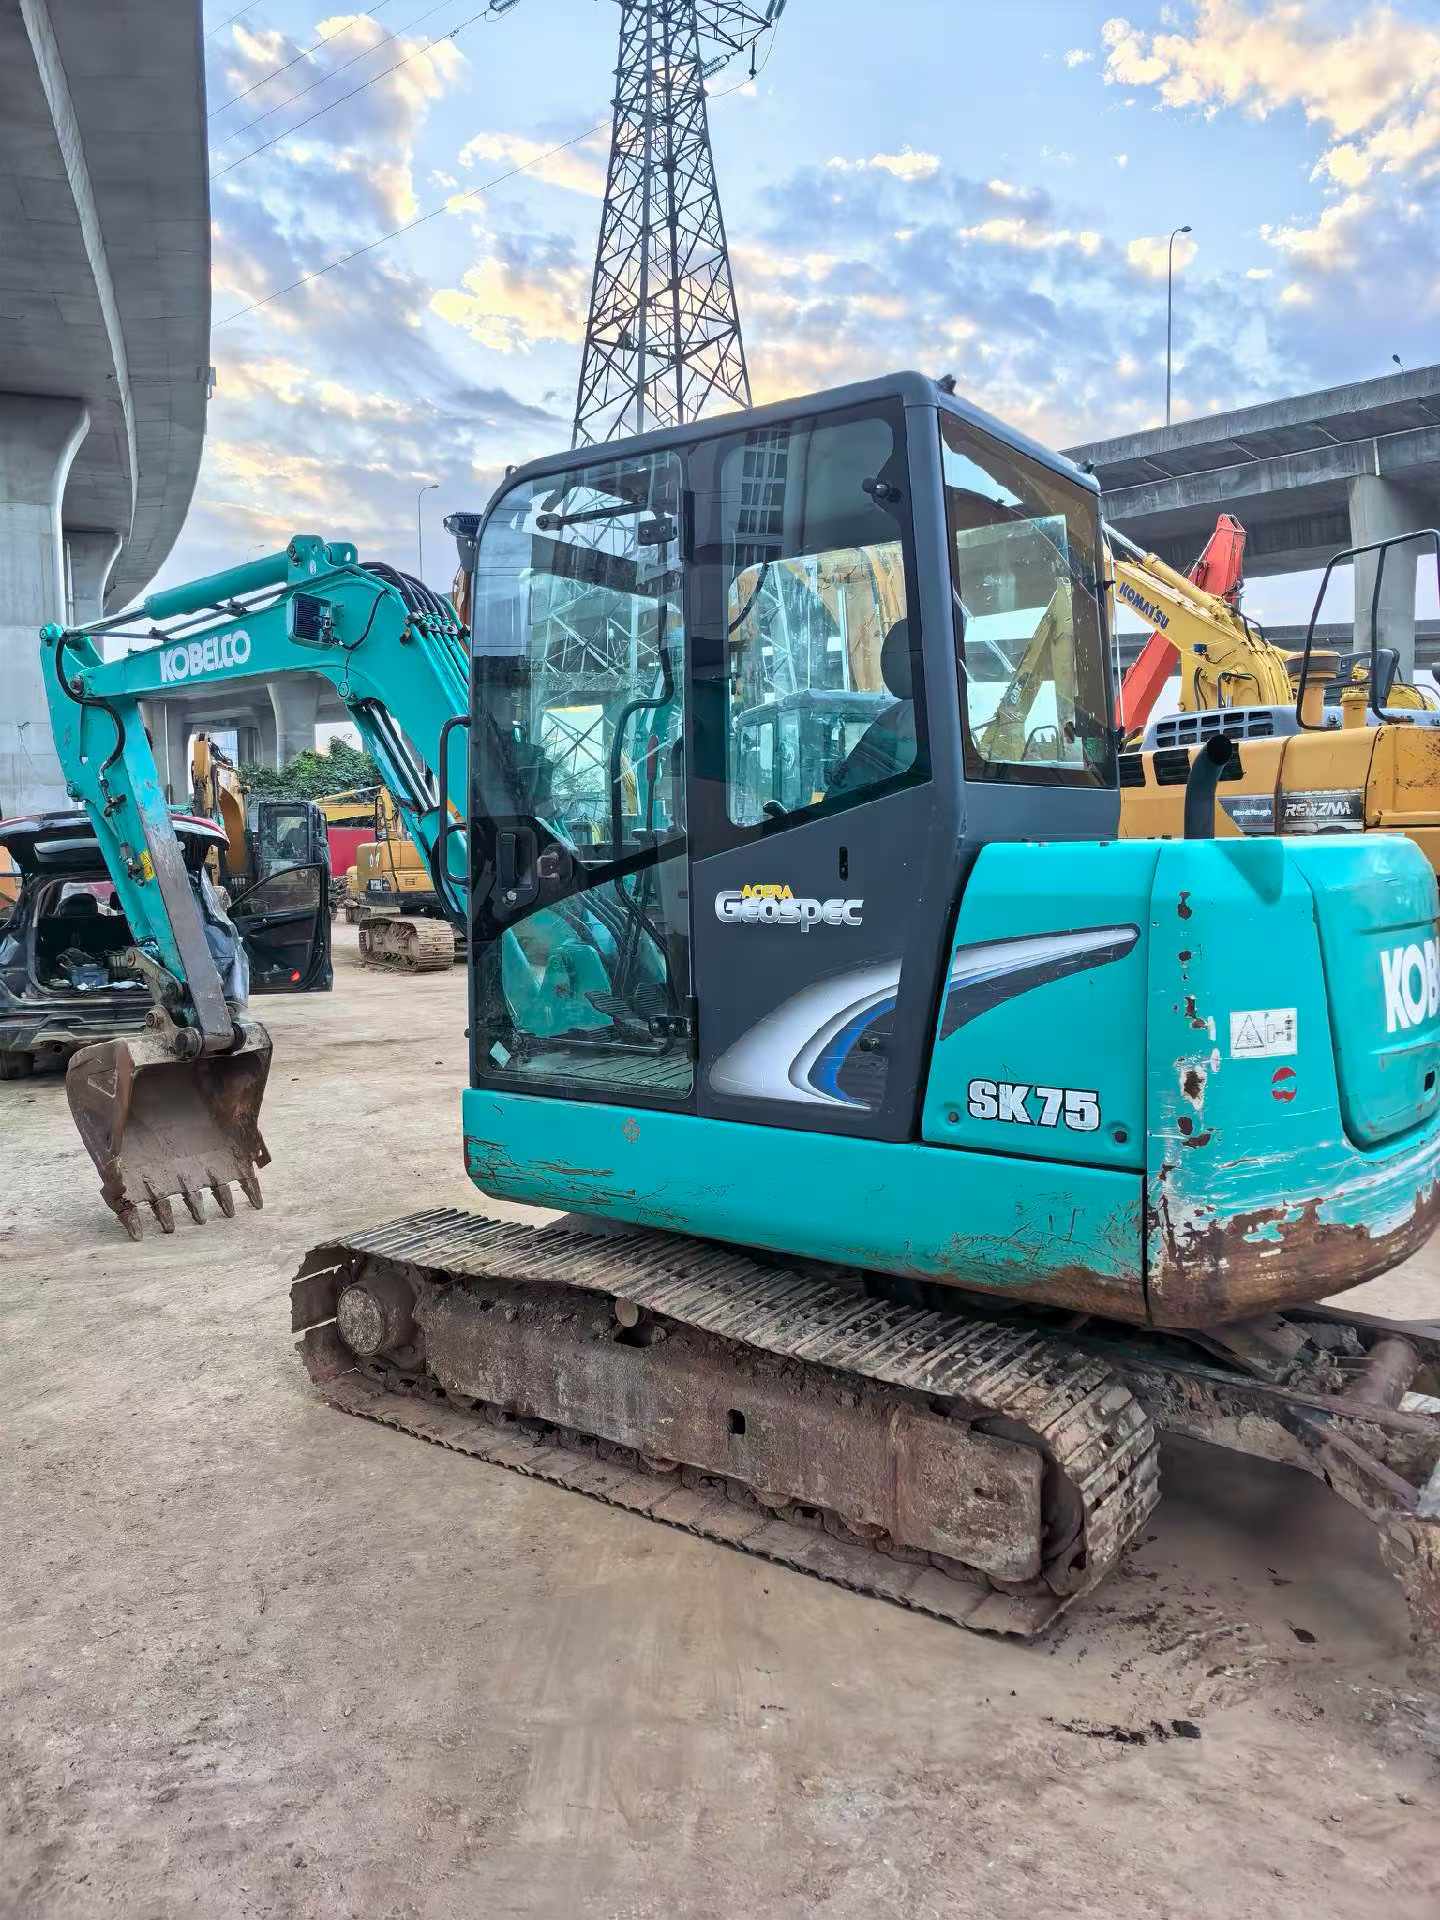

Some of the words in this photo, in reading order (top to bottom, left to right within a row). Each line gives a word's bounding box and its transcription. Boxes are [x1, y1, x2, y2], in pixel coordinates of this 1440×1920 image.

[1119, 581, 1170, 630] KOMATSU
[160, 630, 251, 682] KOBELCO
[741, 884, 794, 900] ACERA
[1380, 936, 1440, 1033] KOB
